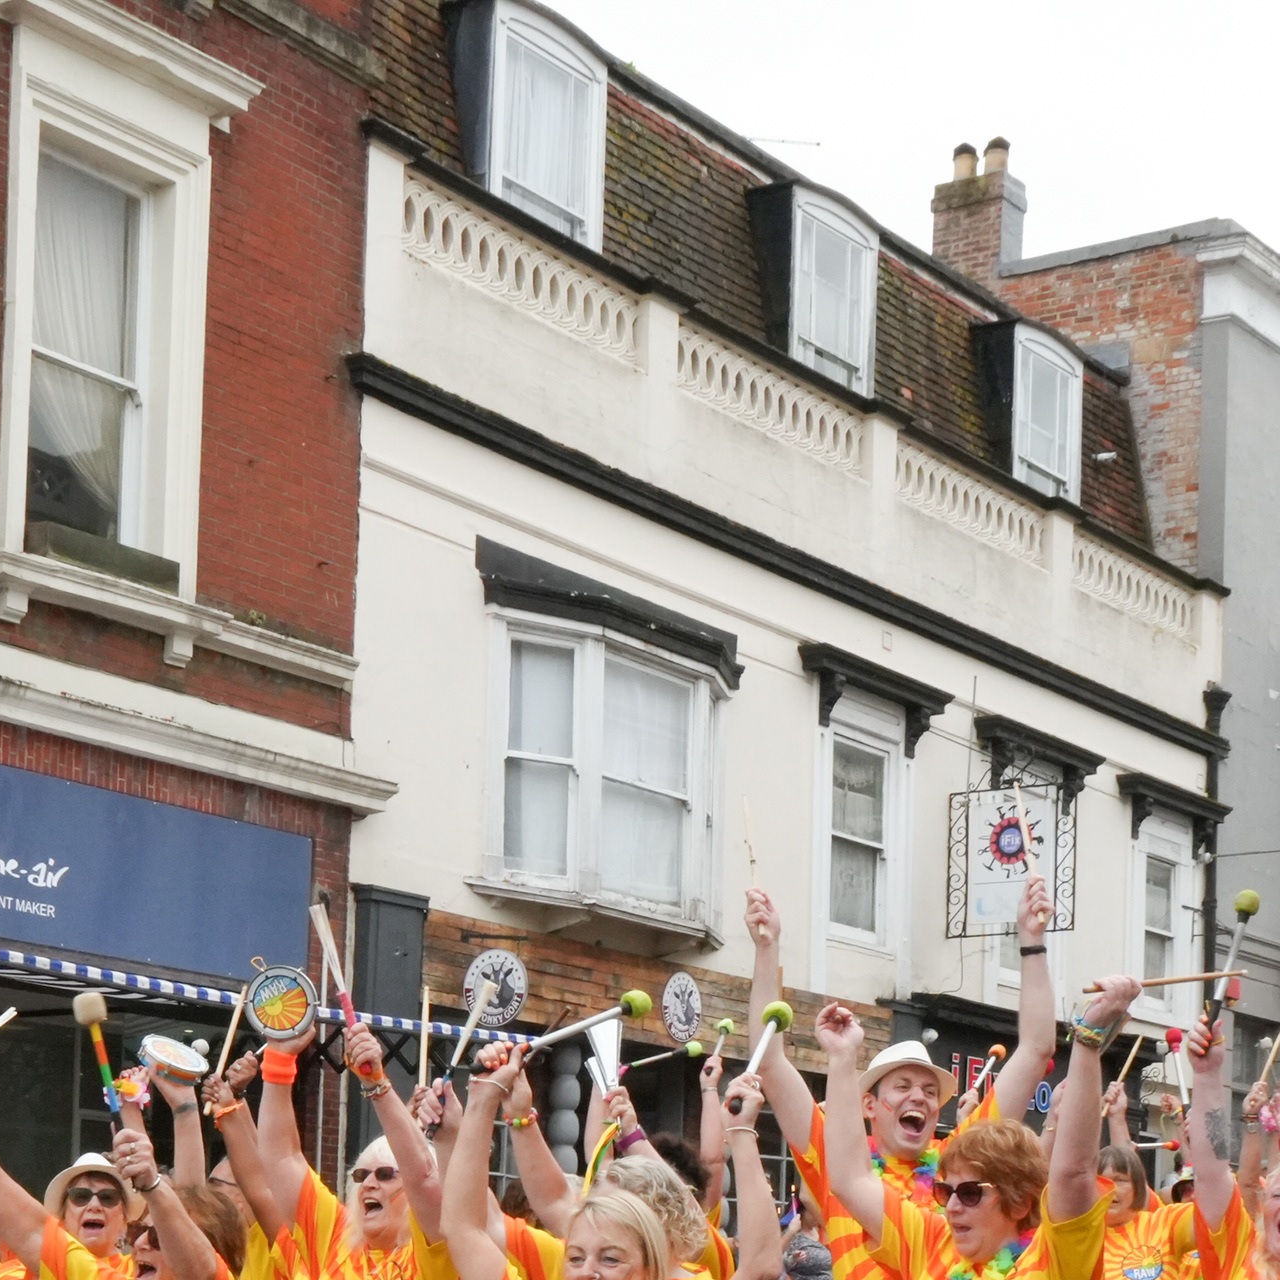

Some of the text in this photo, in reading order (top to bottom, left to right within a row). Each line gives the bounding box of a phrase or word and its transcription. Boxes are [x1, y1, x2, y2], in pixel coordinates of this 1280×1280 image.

[1001, 834, 1021, 846] iFix
[15, 899, 56, 918] MAKER
[503, 993, 522, 1019] GOAT
[1133, 1267, 1156, 1280] RAW
